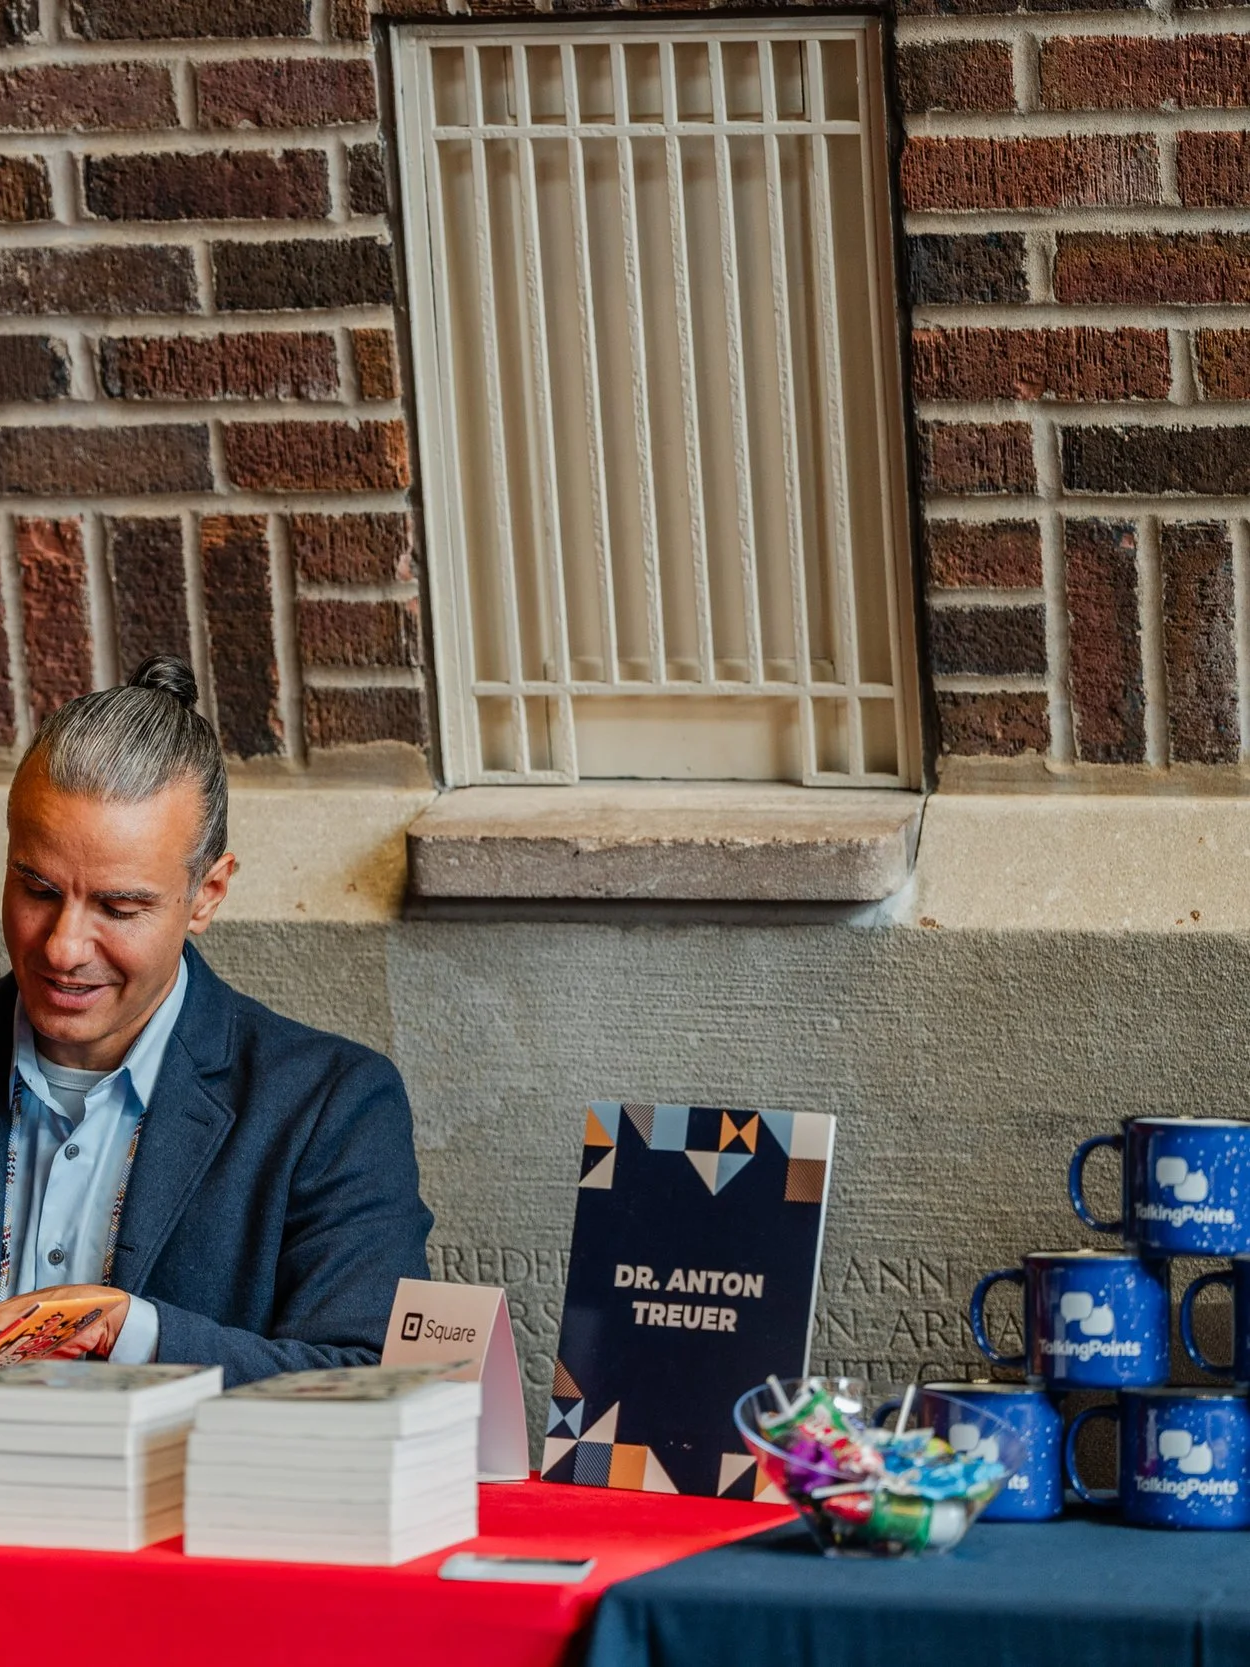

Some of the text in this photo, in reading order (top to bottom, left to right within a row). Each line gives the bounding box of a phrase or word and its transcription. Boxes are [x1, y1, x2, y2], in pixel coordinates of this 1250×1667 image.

[1134, 1202, 1235, 1228] TalkingPoints
[614, 1264, 764, 1298] DR. ANTON
[632, 1301, 738, 1332] TREUER
[424, 1319, 477, 1344] Square
[1039, 1339, 1141, 1361] TalkingPoints
[1135, 1475, 1238, 1500] TalkingPoints
